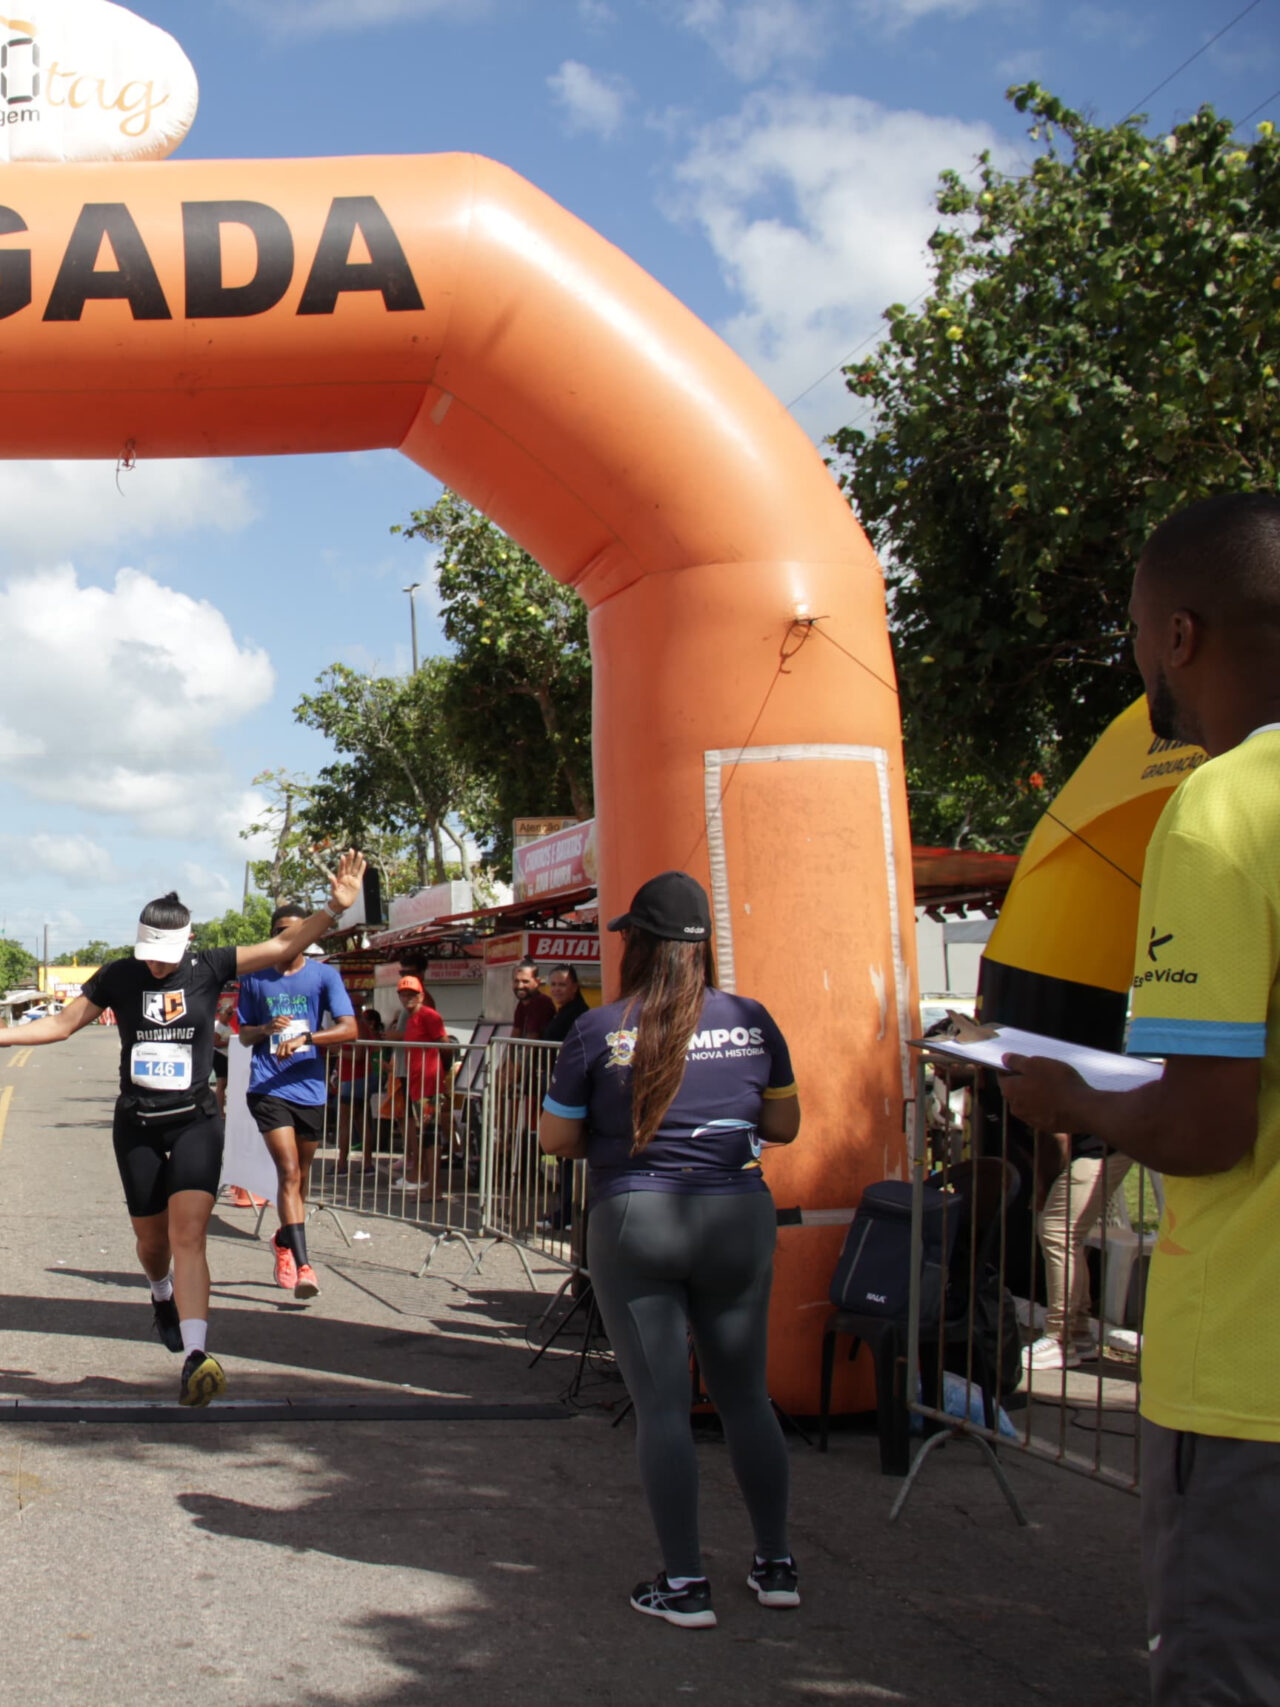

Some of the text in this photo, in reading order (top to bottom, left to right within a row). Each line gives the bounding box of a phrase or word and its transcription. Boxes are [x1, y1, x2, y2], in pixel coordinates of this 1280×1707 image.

[136, 1027, 196, 1041] RUNNING
[691, 1050, 724, 1061] NOVA
[145, 1061, 175, 1077] 146
